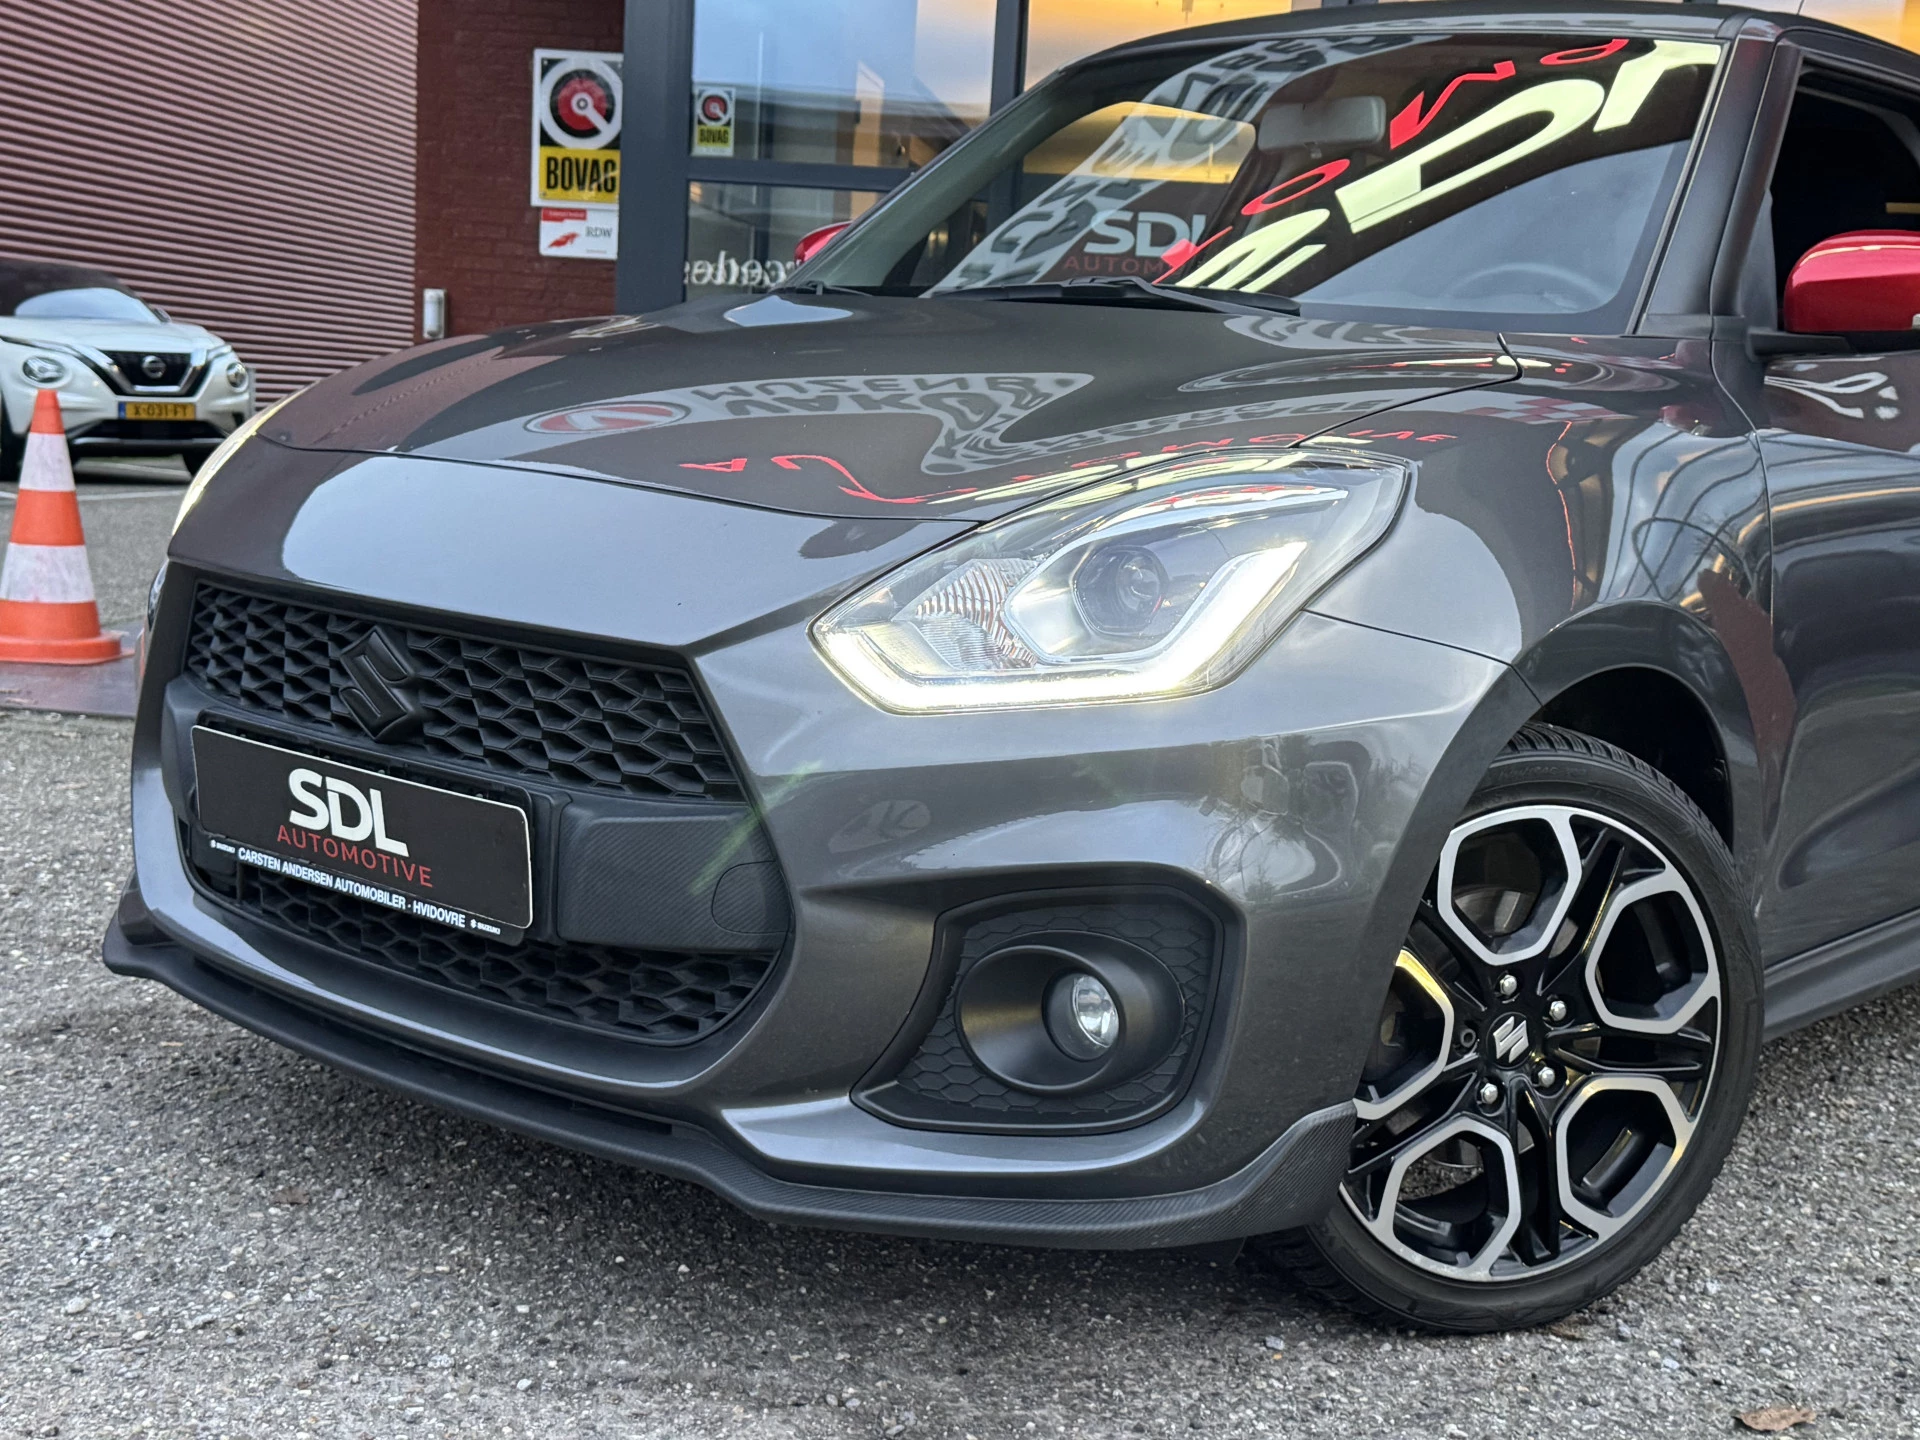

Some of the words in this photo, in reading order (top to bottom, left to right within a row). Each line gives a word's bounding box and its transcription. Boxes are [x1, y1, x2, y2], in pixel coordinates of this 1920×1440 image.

[699, 128, 730, 144] BOVAG
[546, 156, 617, 193] BOVAG
[585, 226, 613, 238] RDW
[1062, 255, 1176, 276] AUTOM
[288, 768, 410, 858] SDL
[276, 825, 434, 888] AUTOMOTIVE
[238, 847, 281, 872] CARSTEN
[282, 861, 334, 888] ANDERSEN
[334, 878, 407, 911] AUTOMOBILER
[412, 900, 466, 928] HVIDOVRE
